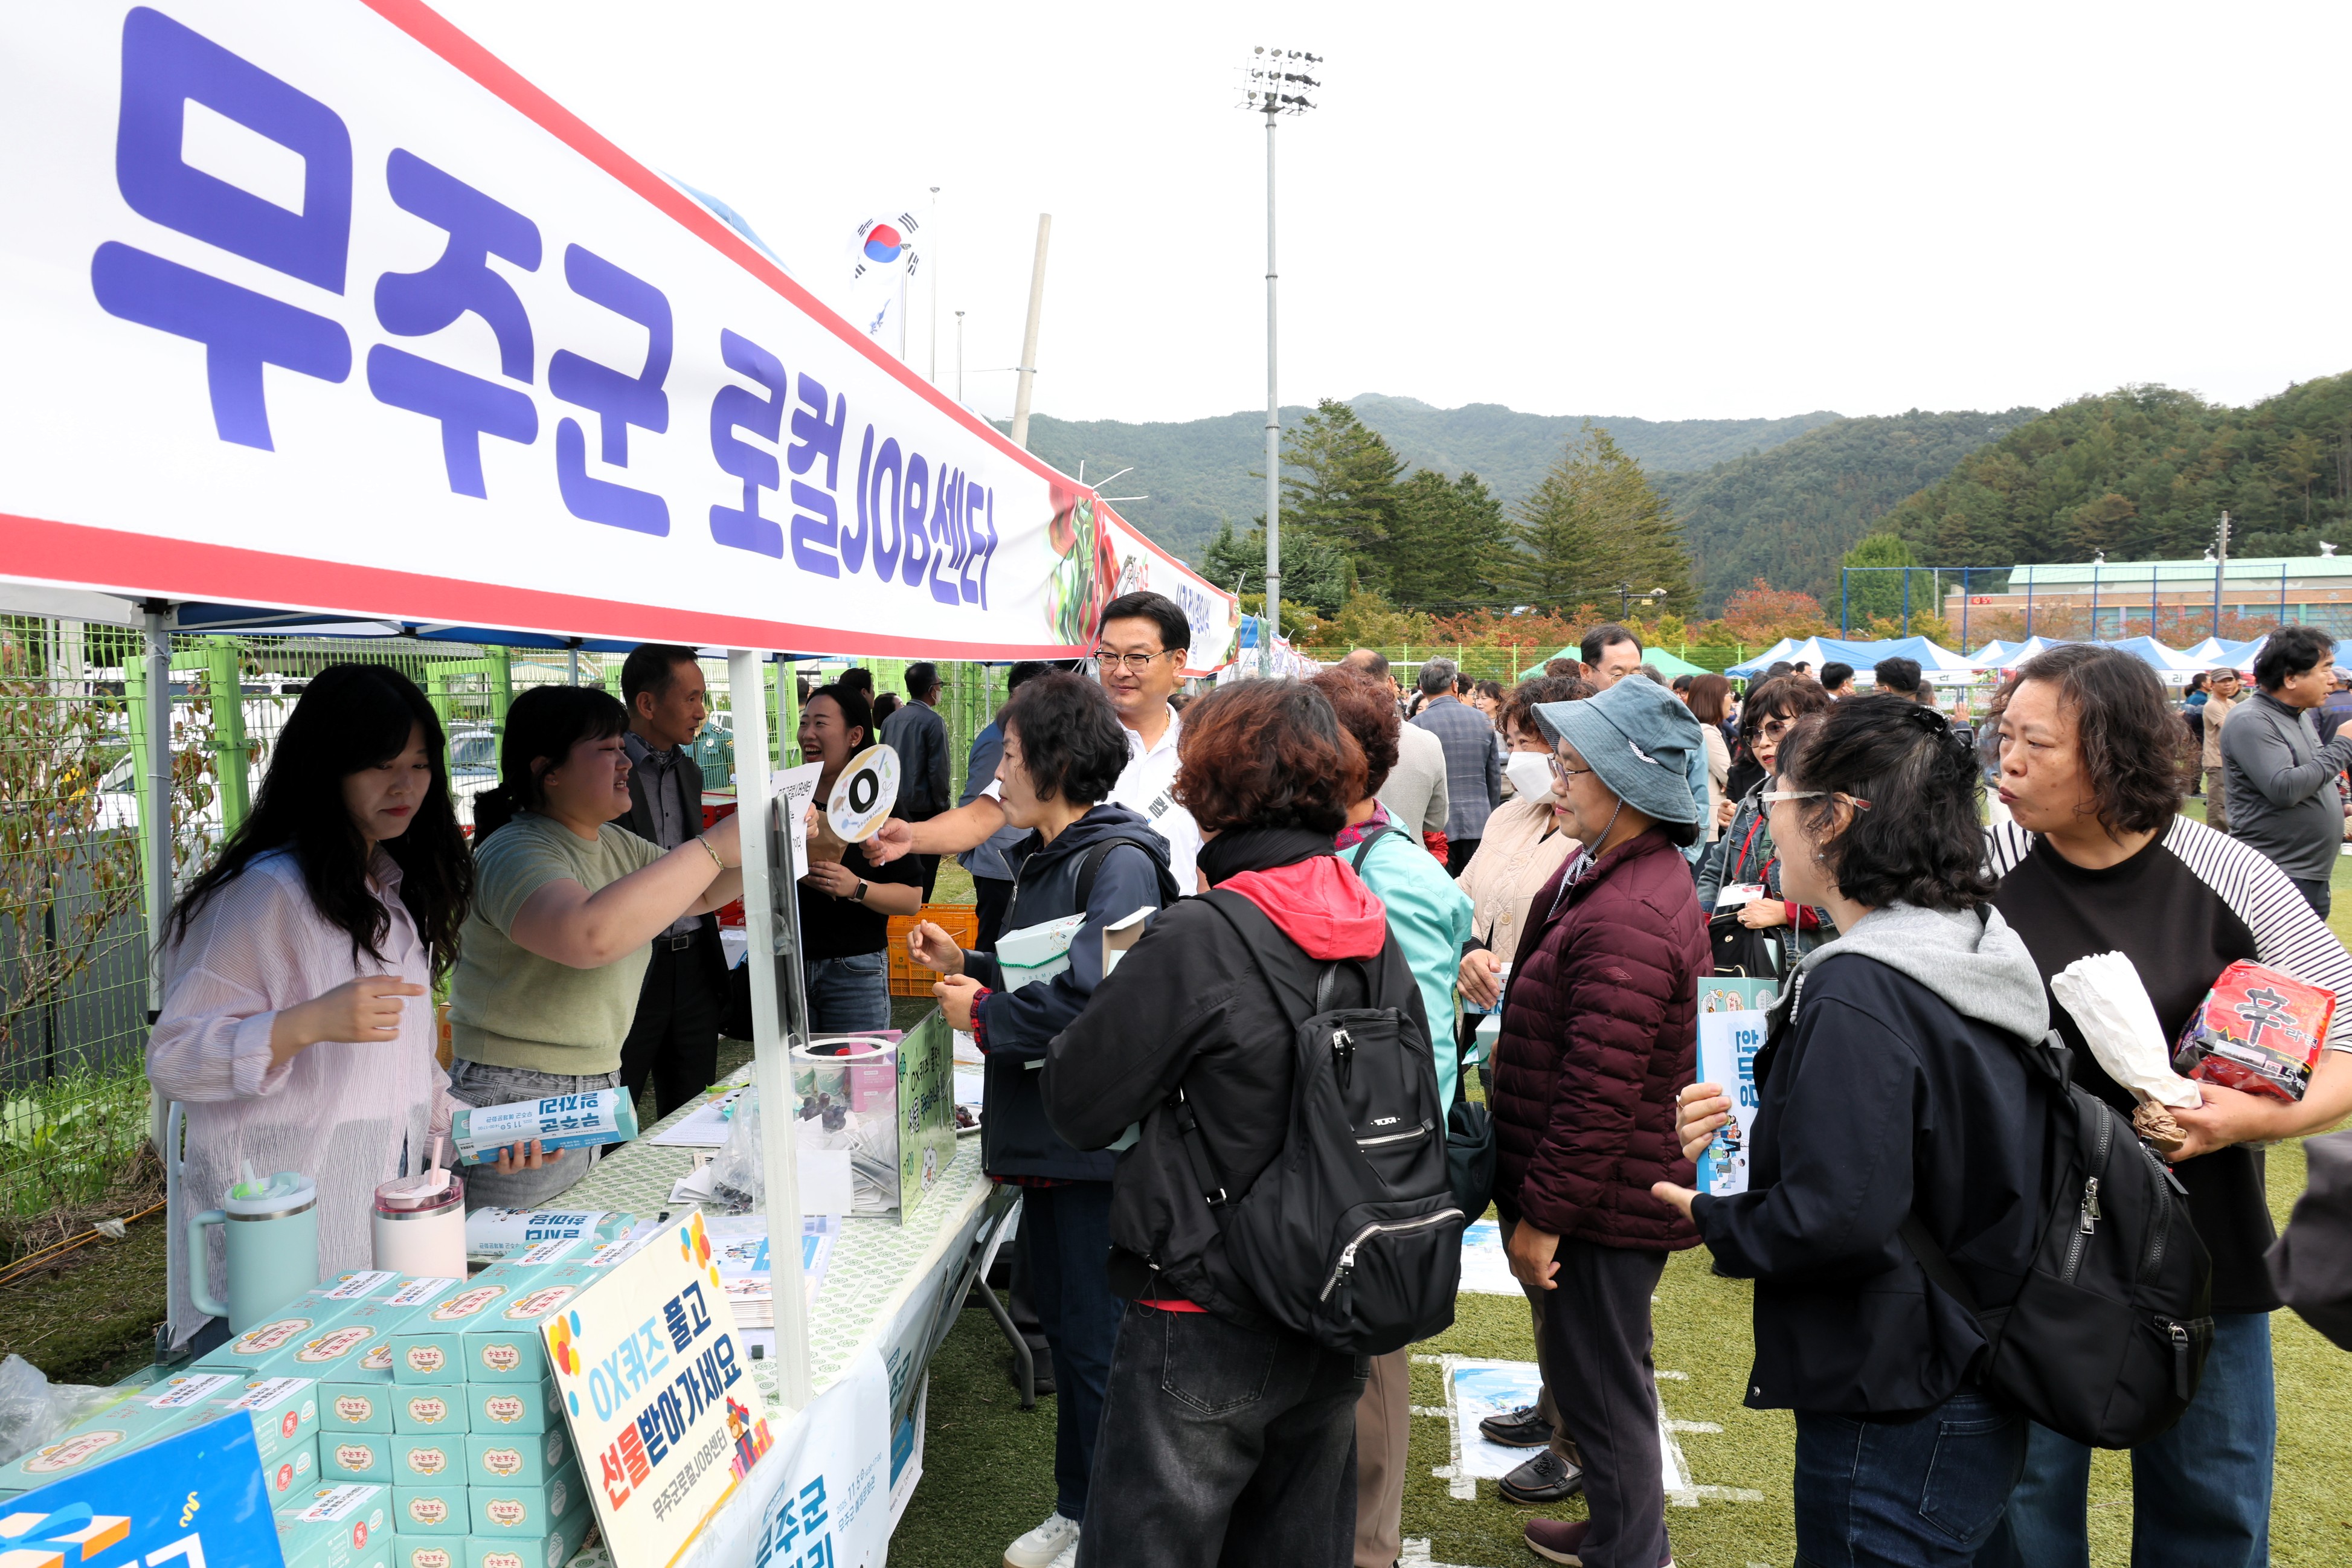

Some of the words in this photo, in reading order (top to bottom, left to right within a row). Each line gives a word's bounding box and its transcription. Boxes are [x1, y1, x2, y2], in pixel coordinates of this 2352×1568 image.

[91, 6, 672, 538] 무주군
[709, 328, 998, 612] 로컬JOB센터
[2235, 988, 2297, 1047] 辛
[2285, 1027, 2318, 1050] 라면
[539, 1092, 599, 1116] 일자리
[539, 1113, 601, 1133] 무주군
[529, 1214, 588, 1226] 한마당
[588, 1315, 670, 1422] OX퀴즈
[663, 1279, 712, 1355] 풀고
